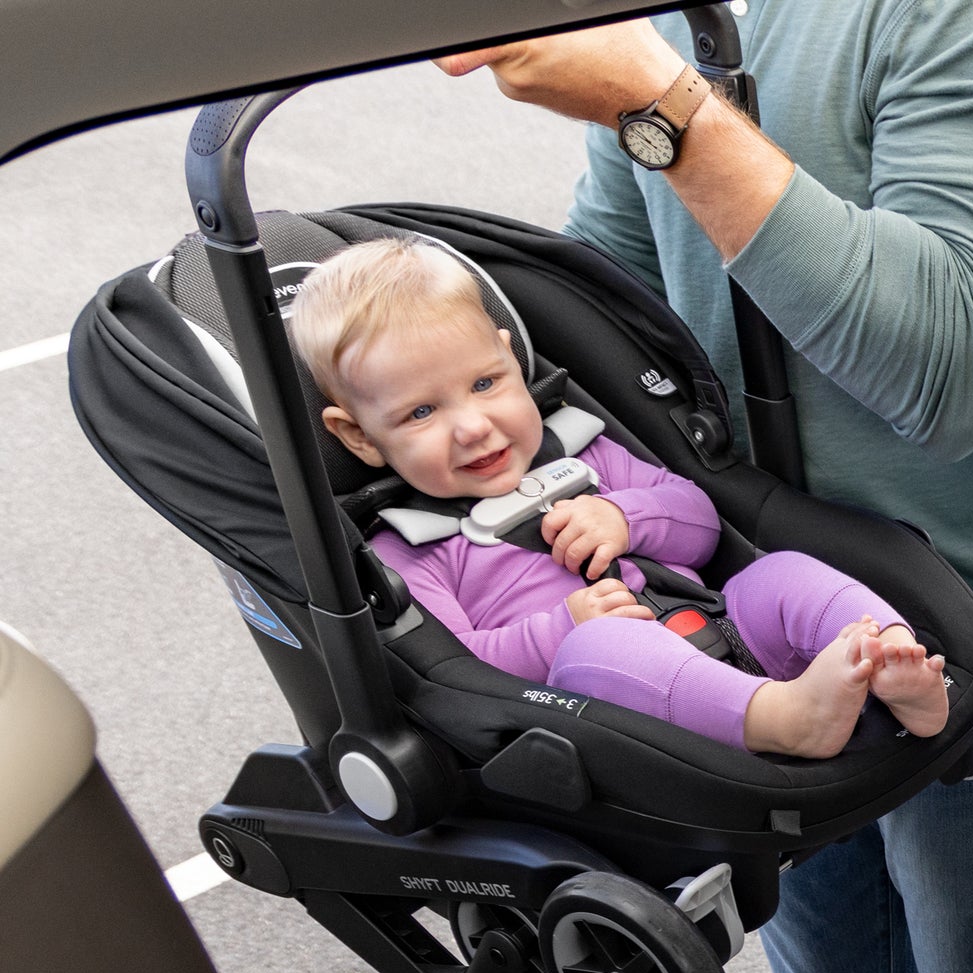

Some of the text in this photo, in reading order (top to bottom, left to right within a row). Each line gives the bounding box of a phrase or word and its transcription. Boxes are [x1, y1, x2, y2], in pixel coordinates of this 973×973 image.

[273, 283, 304, 299] even
[551, 467, 574, 481] SAFE
[523, 689, 578, 710] 3 35lbs
[399, 875, 516, 898] SHYFT DUALRIDE
